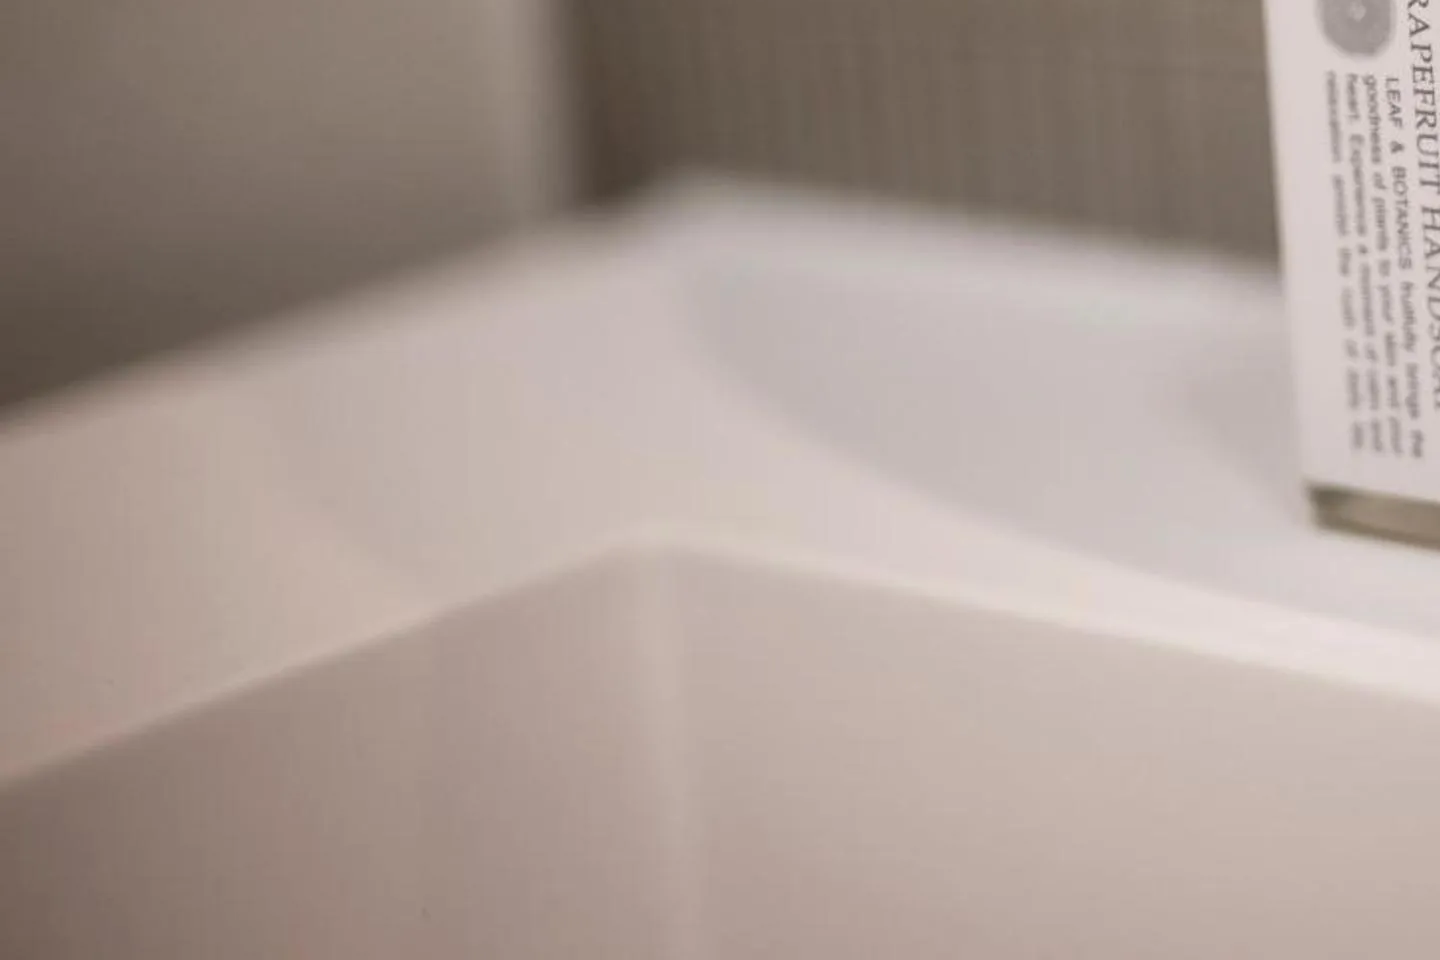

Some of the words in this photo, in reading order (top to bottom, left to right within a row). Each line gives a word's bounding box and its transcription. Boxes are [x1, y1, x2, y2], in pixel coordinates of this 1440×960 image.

[1362, 74, 1381, 165] goodness
[1373, 172, 1386, 190] of
[1386, 77, 1403, 129] LEAF
[1390, 141, 1405, 155] &
[1392, 166, 1413, 270] BOTANICS
